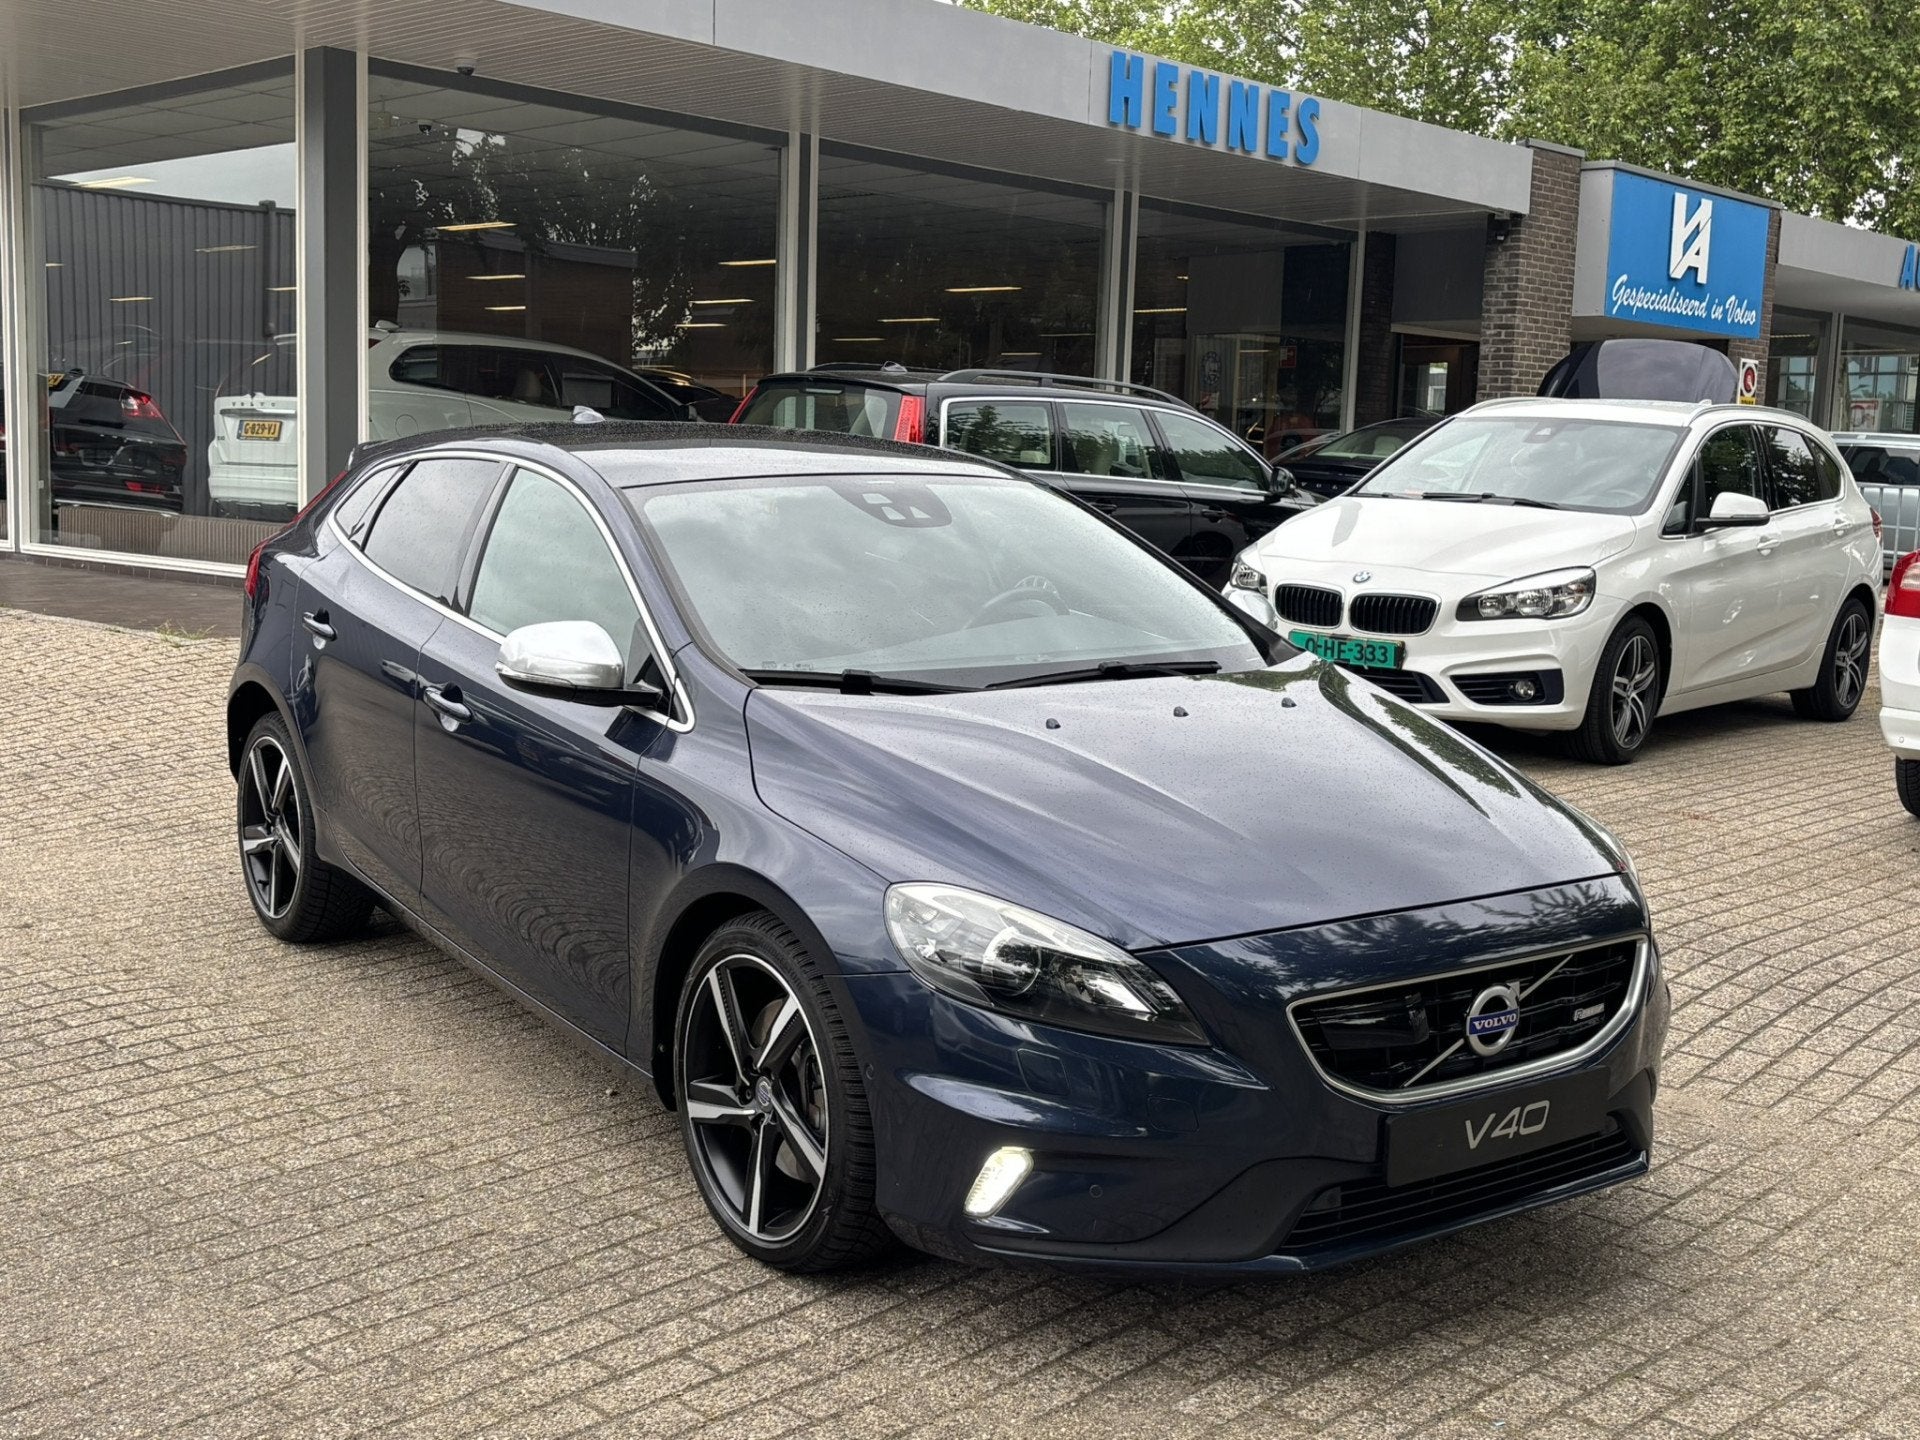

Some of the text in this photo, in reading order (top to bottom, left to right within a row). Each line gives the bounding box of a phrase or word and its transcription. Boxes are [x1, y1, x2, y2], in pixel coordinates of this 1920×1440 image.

[1109, 51, 1320, 166] HENNES
[1900, 243, 1920, 291] A
[1612, 274, 1756, 325] Gespecialiseerd in Volvo
[1473, 1013, 1518, 1030] VOLVO
[1465, 1100, 1550, 1150] V40
